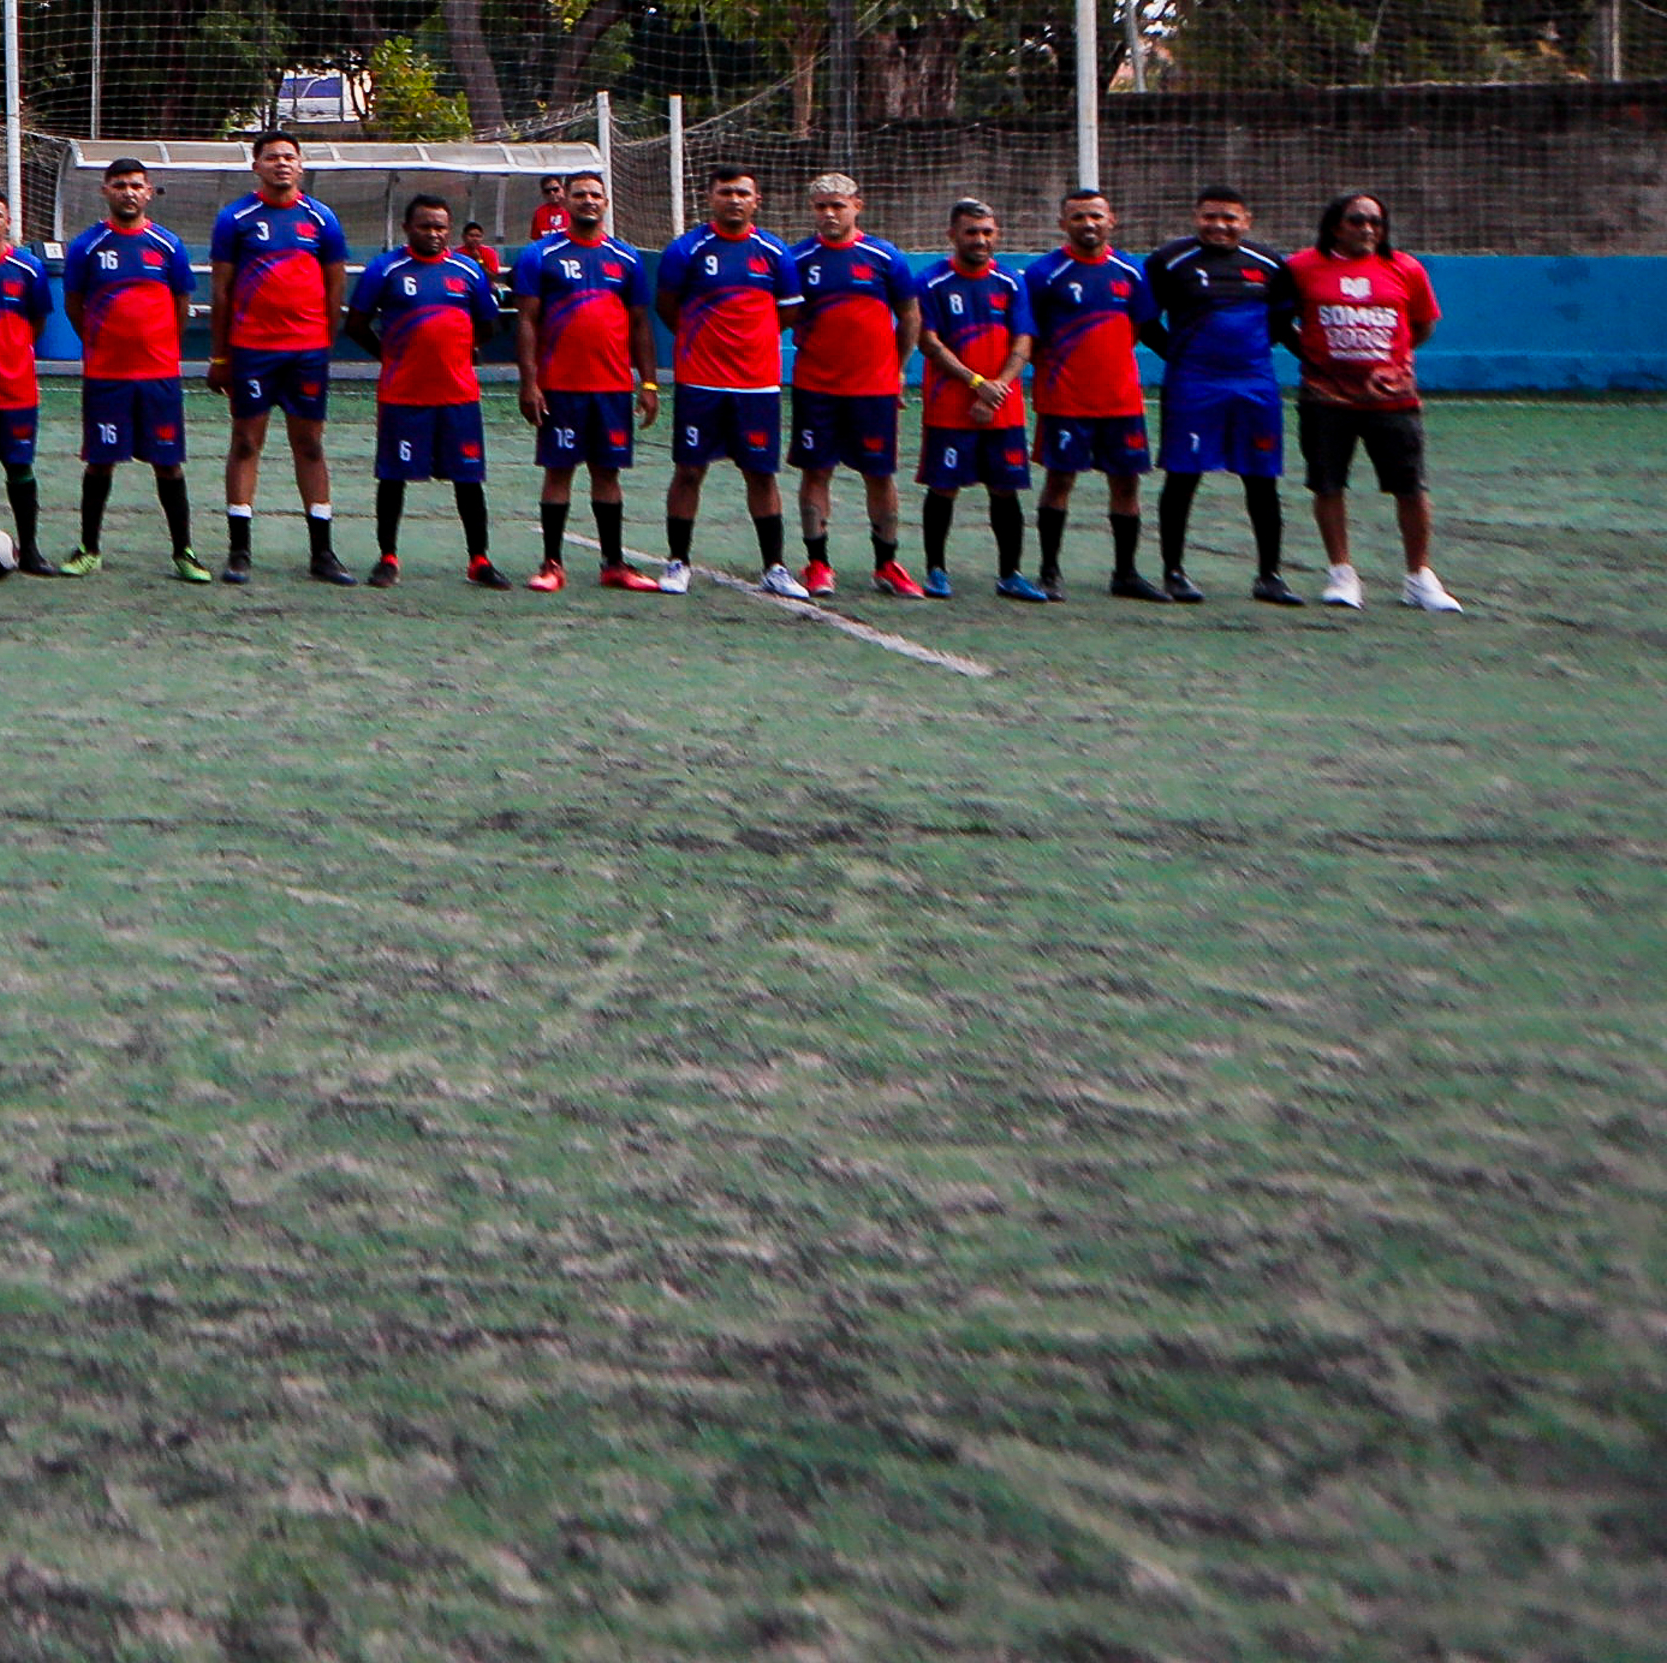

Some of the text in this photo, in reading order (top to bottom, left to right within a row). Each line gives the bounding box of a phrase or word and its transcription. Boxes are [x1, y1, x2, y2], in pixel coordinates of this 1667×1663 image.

[256, 221, 270, 241] 3
[97, 250, 118, 270] 16
[705, 255, 719, 276] 9
[808, 265, 822, 285] 5
[403, 276, 417, 296] 6
[949, 293, 964, 315] 8
[246, 379, 262, 399] 3
[97, 422, 118, 444] 16
[686, 425, 700, 447] 9
[802, 428, 815, 450] 5
[398, 440, 412, 462] 6
